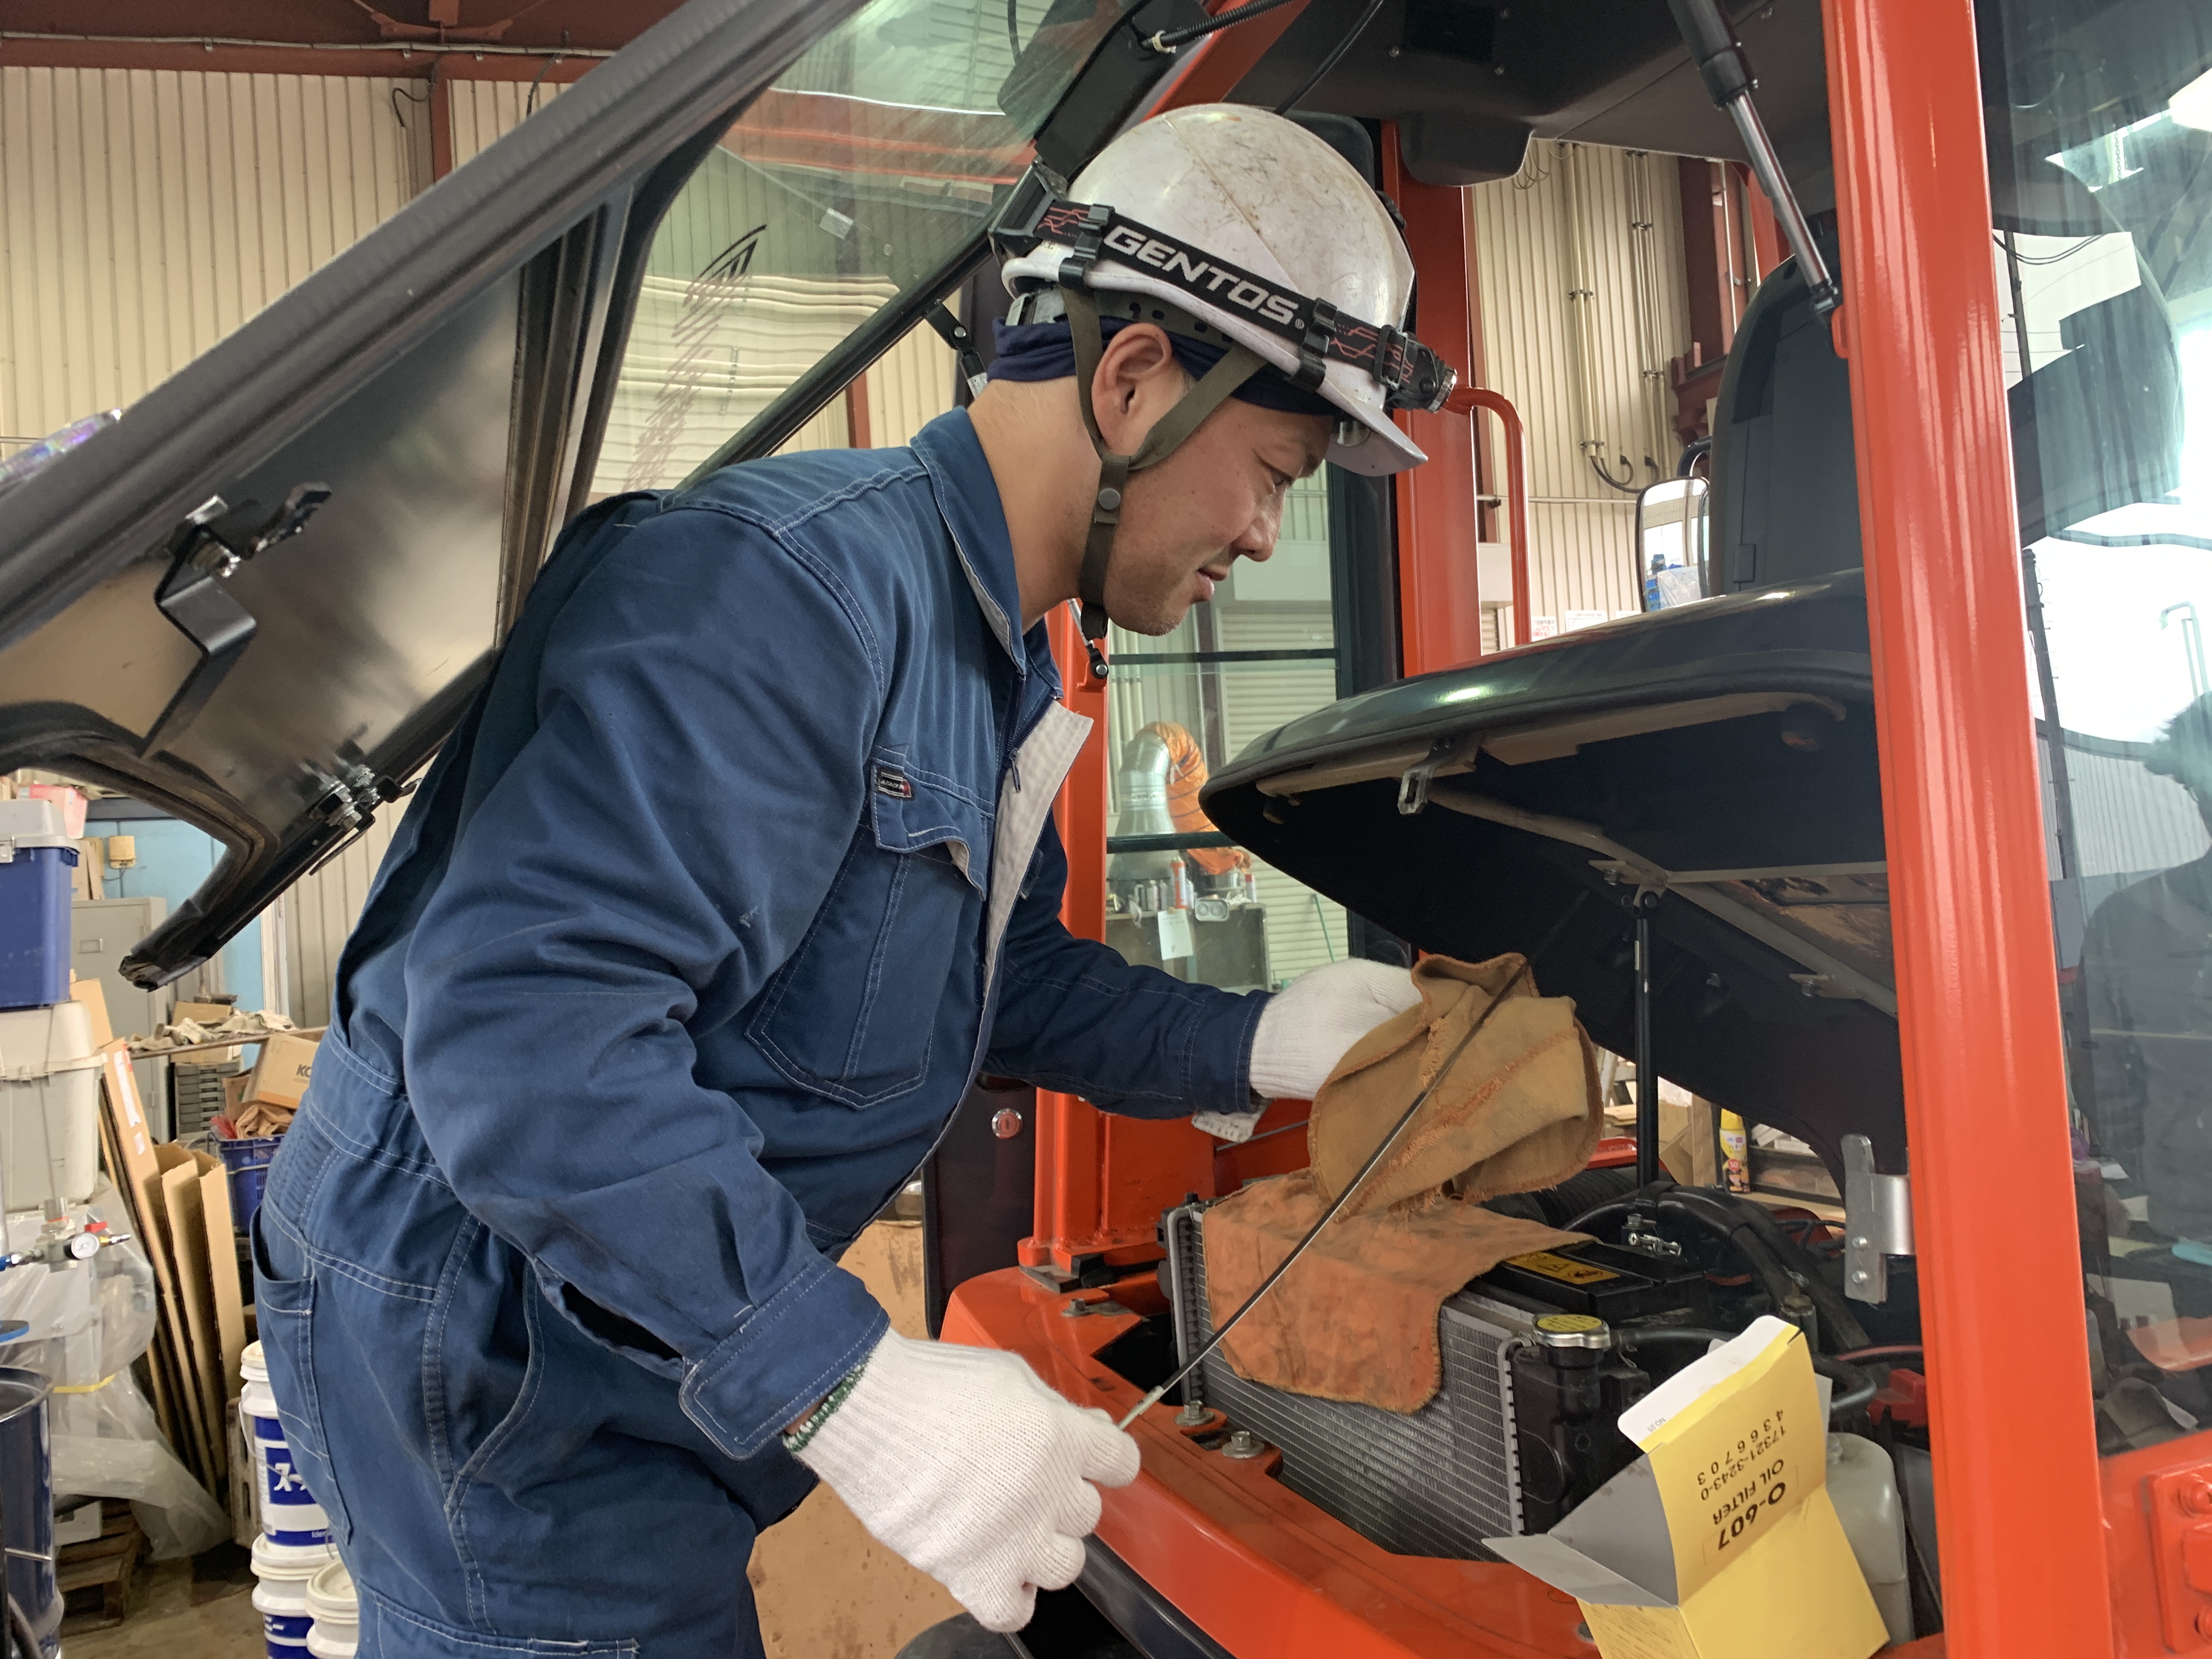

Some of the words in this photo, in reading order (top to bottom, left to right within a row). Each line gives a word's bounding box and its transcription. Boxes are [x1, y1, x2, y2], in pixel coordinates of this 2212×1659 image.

[1103, 225, 1299, 325] GENTOS
[1701, 1425, 1786, 1500] 17321-3243-0
[1759, 1459, 1784, 1484] OIL
[1713, 1480, 1756, 1525] FILTER
[1718, 1482, 1786, 1550] O-607
